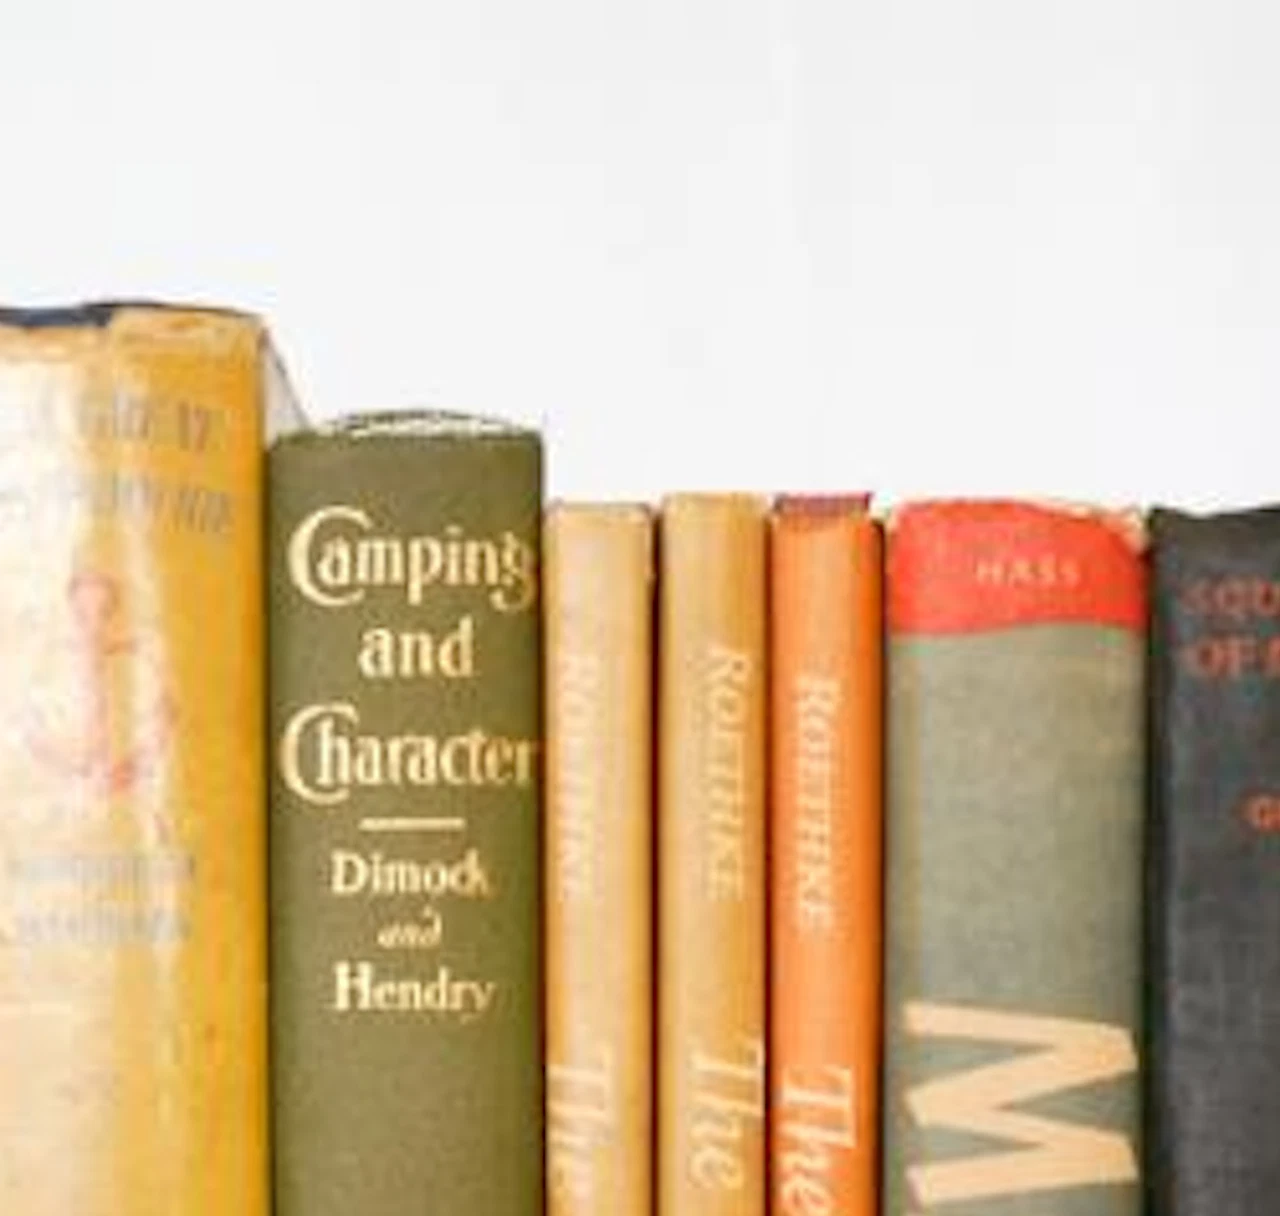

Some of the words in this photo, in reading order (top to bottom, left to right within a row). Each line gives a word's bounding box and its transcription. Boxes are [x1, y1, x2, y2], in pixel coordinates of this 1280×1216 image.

[288, 506, 538, 612] Camping
[976, 556, 1078, 587] HASS
[357, 614, 475, 680] and
[1187, 638, 1256, 678] OF
[280, 703, 537, 806] Character
[704, 645, 748, 904] ROETHKE
[794, 674, 842, 932] ROETHKE
[329, 849, 491, 899] Dimock
[377, 907, 444, 950] and
[331, 960, 496, 1020] Hendry
[546, 1045, 613, 1205] The
[687, 1035, 765, 1192] The
